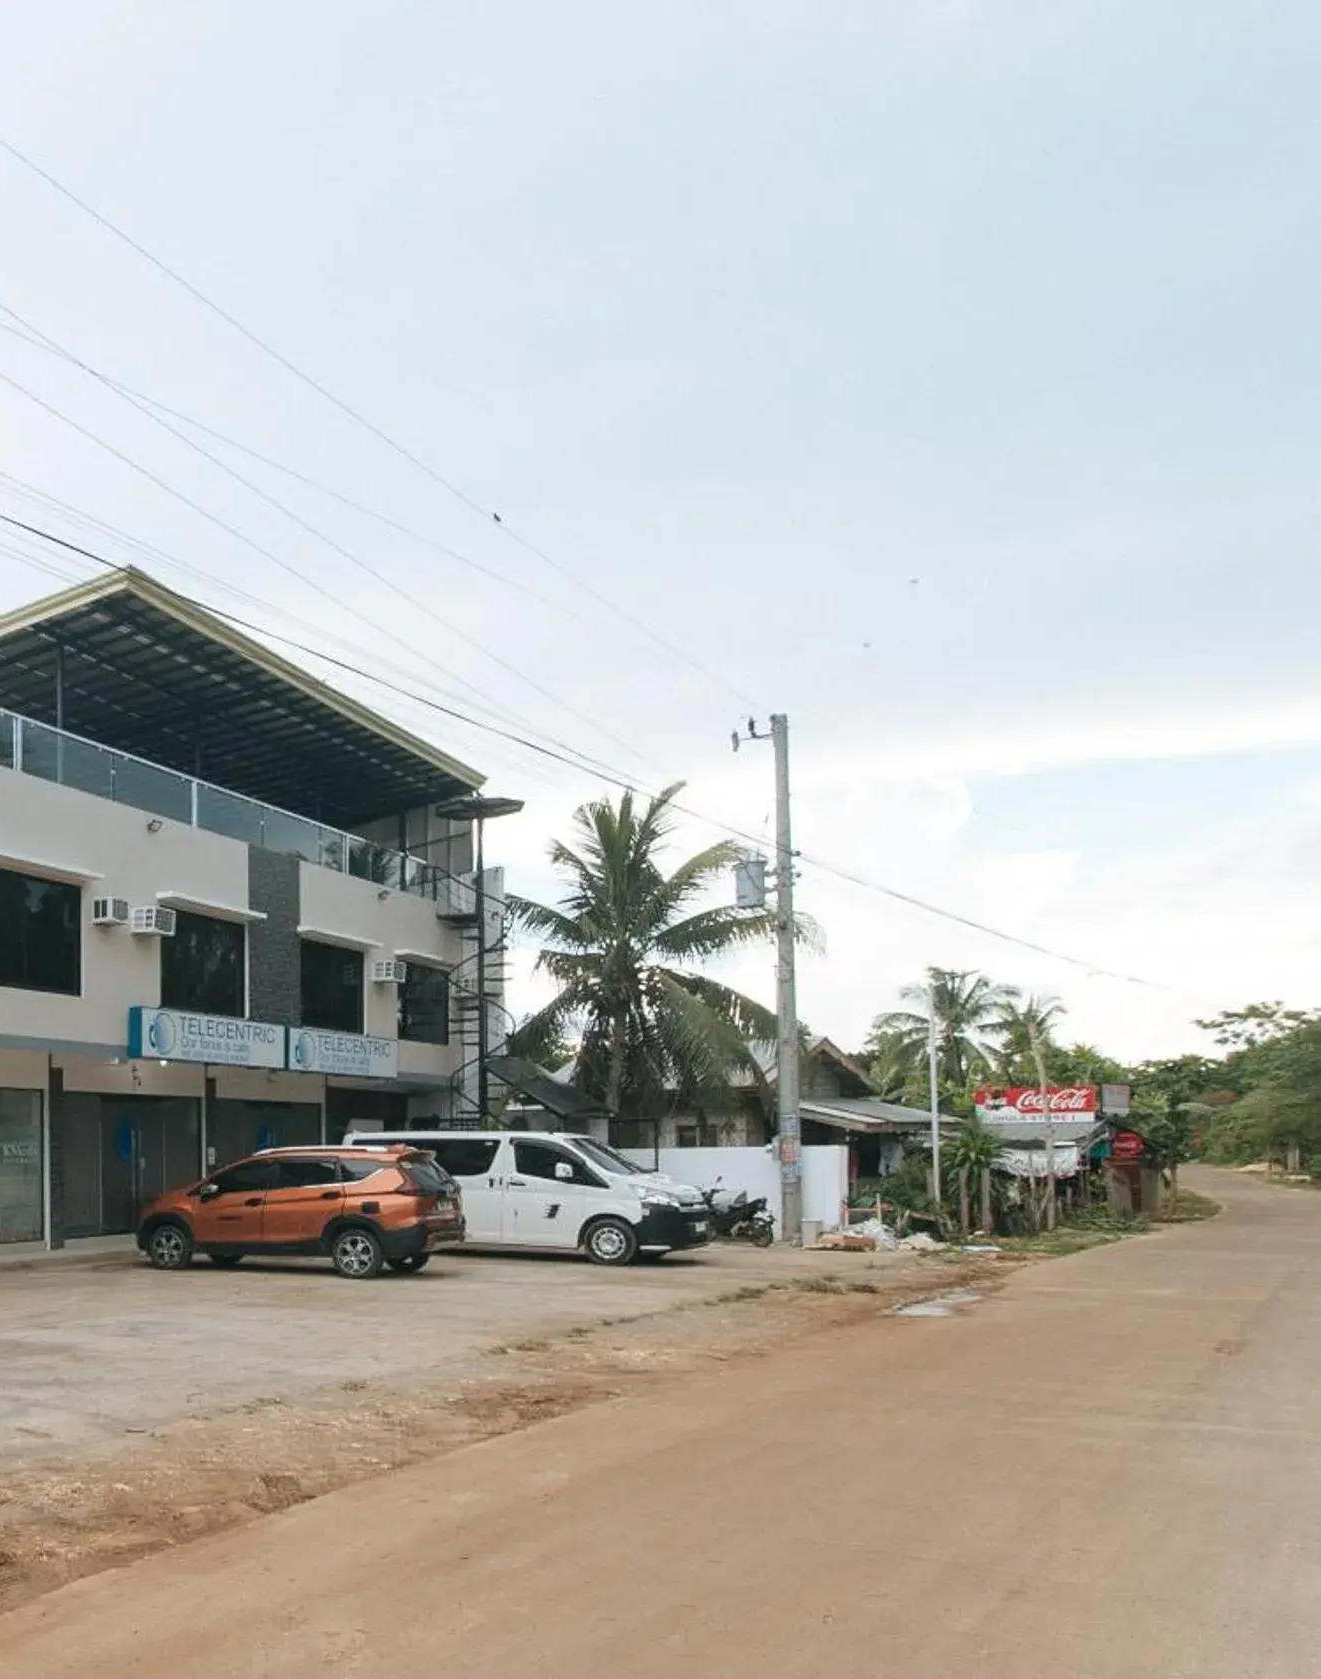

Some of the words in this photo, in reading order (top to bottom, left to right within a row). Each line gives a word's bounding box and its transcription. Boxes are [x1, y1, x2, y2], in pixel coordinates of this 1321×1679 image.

[178, 1015, 277, 1044] TELECENTRIC
[318, 1034, 391, 1058] TELECENTRIC
[1016, 1088, 1091, 1110] CocCola
